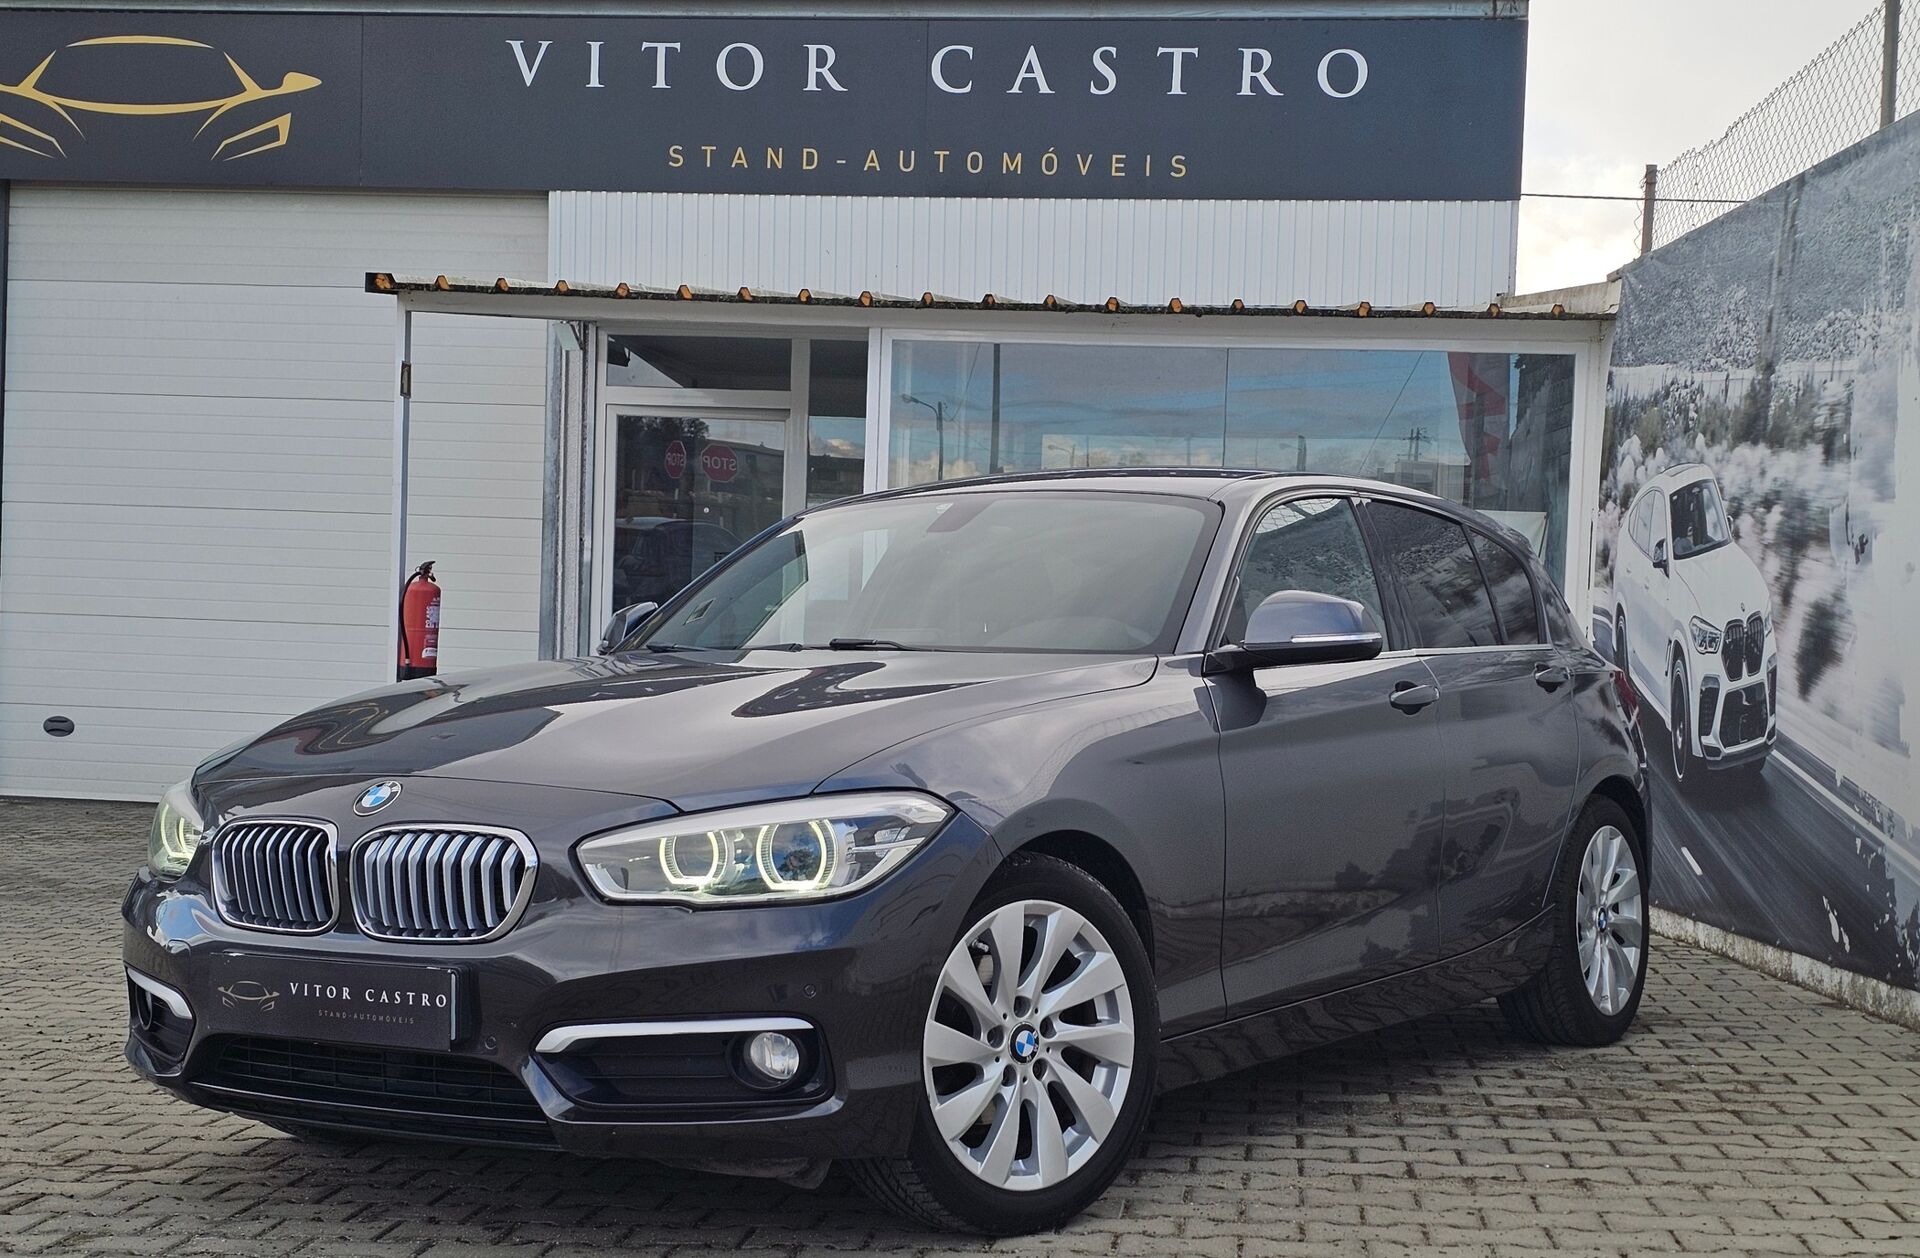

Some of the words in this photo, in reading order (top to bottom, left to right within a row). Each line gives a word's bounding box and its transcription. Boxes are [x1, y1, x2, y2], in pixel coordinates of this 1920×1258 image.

[505, 39, 849, 92] VITOR
[931, 44, 1369, 99] CASTRO
[668, 145, 1190, 179] STAND-AUTOMÓVEIS
[289, 982, 351, 1000] VITOR
[365, 988, 447, 1008] CASTRO
